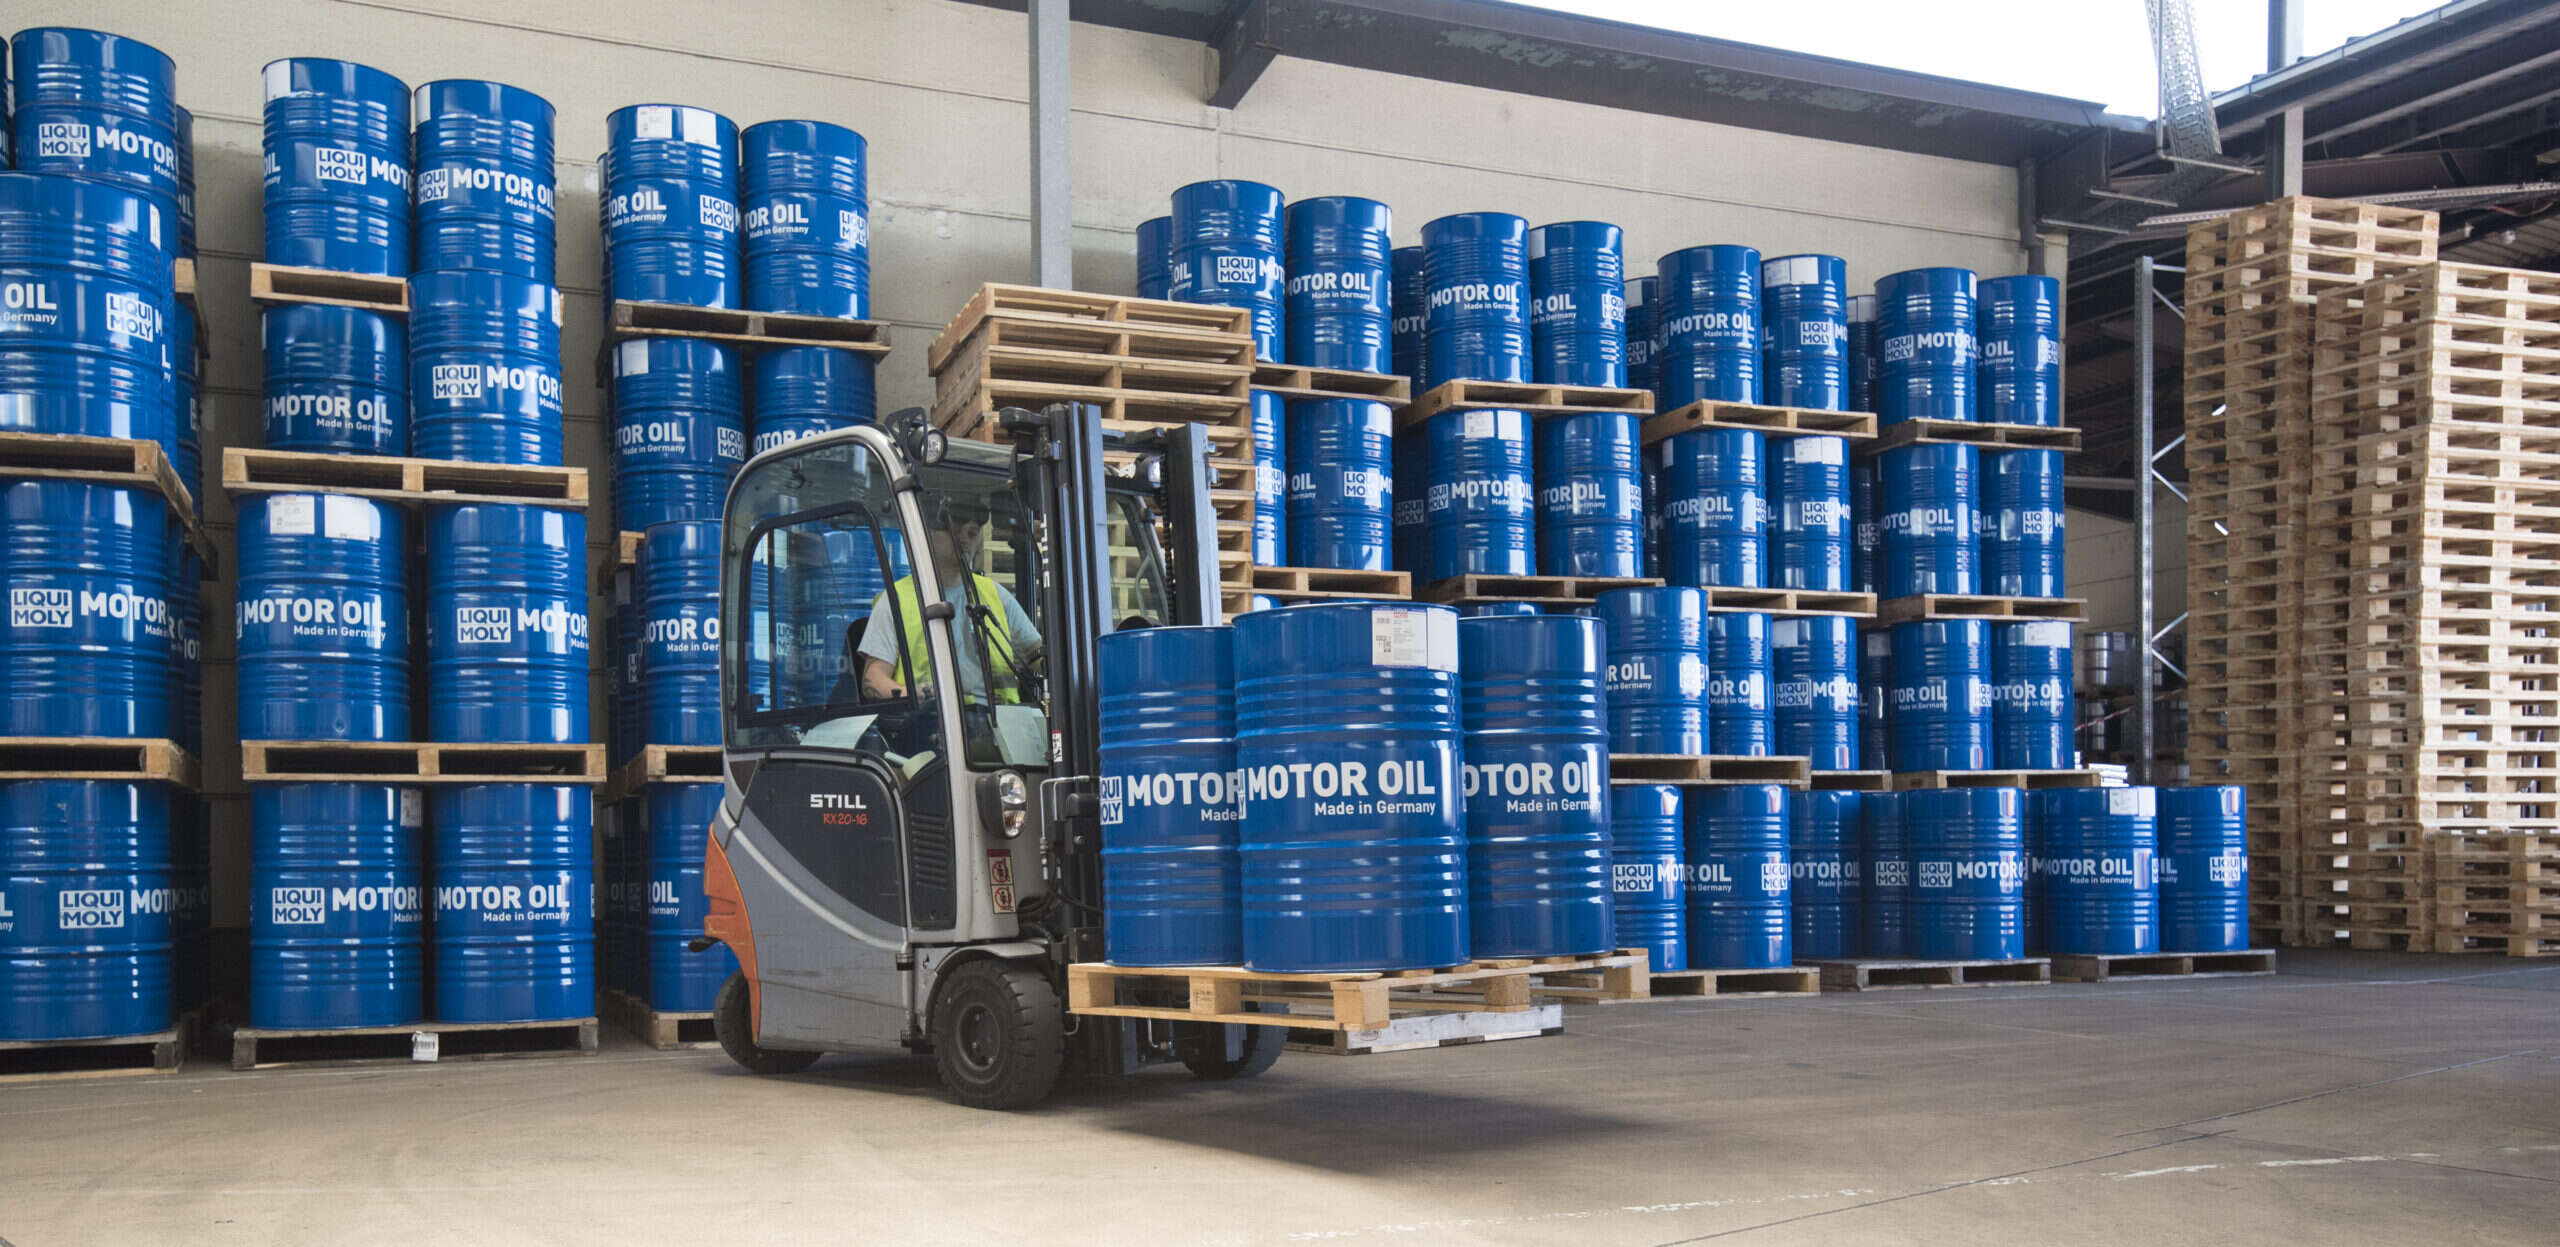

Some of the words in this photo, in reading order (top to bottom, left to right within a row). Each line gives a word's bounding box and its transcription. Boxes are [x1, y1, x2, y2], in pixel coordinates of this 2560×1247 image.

[41, 125, 88, 140] LIQUI
[42, 141, 89, 156] MOLY
[96, 125, 176, 171] MOTOR
[319, 149, 365, 170] LIQUI
[319, 163, 366, 183] MOLY
[371, 156, 412, 192] MOT
[452, 167, 536, 200] MOTOR
[504, 195, 529, 208] Made
[632, 189, 667, 211] OIL
[701, 195, 734, 216] LIQUI
[631, 212, 667, 224] Germany
[773, 203, 809, 224] OIL
[701, 212, 734, 233] MOLY
[772, 224, 809, 236] Germany
[1219, 256, 1254, 269] LIQUI
[1173, 261, 1193, 284] OIL
[1219, 269, 1255, 283] MOLY
[1341, 271, 1371, 291] OIL
[5, 283, 58, 311] OIL
[1311, 290, 1331, 300] Made
[1340, 290, 1371, 301] Germany
[1431, 284, 1490, 309] MOTOR
[1493, 282, 1520, 304] OIL
[1546, 293, 1576, 312] OIL
[108, 295, 153, 322] LIQUI
[1463, 301, 1482, 311] Made
[1484, 301, 1491, 311] in
[1492, 302, 1520, 314] Germy
[1545, 311, 1576, 323] Germany
[1669, 313, 1729, 337] MOTOR
[1732, 313, 1755, 333] OIL
[108, 314, 154, 341] MOLY
[1703, 330, 1722, 340] Made
[1801, 322, 1831, 334] LIQU
[1886, 335, 1913, 352] LIQUI
[1917, 331, 1972, 352] MOTOR
[1985, 340, 2014, 358] OIL
[1886, 347, 1913, 362] MOLY
[436, 365, 479, 381] LIQUI
[436, 382, 480, 398] MOLY
[487, 366, 560, 403] MOTOR
[271, 395, 351, 419] MOTOR
[357, 399, 394, 427] OIL
[316, 417, 347, 430] Made
[350, 420, 359, 430] in
[649, 422, 686, 442] OIL
[648, 443, 686, 455] Germany
[1291, 471, 1316, 493] OIL
[1450, 480, 1511, 500] MOTOR
[1540, 486, 1571, 507] TOR
[1576, 482, 1605, 501] OIL
[1703, 495, 1734, 513] OIL
[1803, 514, 1830, 525] MOL
[1925, 508, 1954, 524] OIL
[14, 590, 71, 607] LIQUI
[81, 590, 167, 626] MOTOR
[244, 598, 337, 625] MOTOR
[342, 600, 387, 629] OIL
[459, 608, 509, 624] LIQUI
[14, 608, 71, 626] MOLY
[517, 607, 588, 639] MOTOR
[293, 625, 325, 636] Made
[327, 625, 339, 636] in
[341, 626, 387, 643] Germy
[460, 625, 510, 642] MOLY
[666, 643, 689, 654] Made
[691, 642, 700, 653] in
[1621, 662, 1652, 681] OIL
[1620, 680, 1652, 693] Germany
[1777, 683, 1808, 694] LIQUI
[1918, 684, 1948, 702] OIL
[2040, 683, 2065, 700] OIL
[1777, 694, 1808, 706] MOLY
[1247, 762, 1369, 801] MOTOR
[1378, 760, 1436, 796] OIL
[1127, 772, 1239, 807] MOTOR
[809, 793, 868, 809] STILL
[1314, 802, 1354, 816] Made
[1359, 800, 1373, 814] in
[1376, 800, 1436, 816] Germany
[1506, 799, 1544, 813] Made
[1546, 799, 1559, 812] in
[1201, 808, 1238, 822] Made
[1614, 865, 1652, 878] LIQUI
[1657, 863, 1685, 883] MOT
[1698, 863, 1732, 882] OIL
[1877, 863, 1908, 874] LIQU
[1919, 863, 1952, 874] LIQUI
[1956, 861, 2018, 881] MOTOR
[2100, 857, 2133, 876] OIL
[1614, 879, 1653, 891] MOLY
[1697, 882, 1732, 895] Germany
[1919, 874, 1952, 887] MOLY
[2070, 876, 2088, 886] Made
[2099, 875, 2133, 887] Germany
[63, 892, 122, 909] LIQUI
[274, 889, 323, 905] LIQUI
[332, 886, 418, 911] MOTOR
[438, 885, 523, 911] MOTOR
[529, 884, 570, 909] OIL
[652, 881, 680, 904] OIL
[62, 910, 122, 927] MOLY
[274, 907, 323, 923] MOLY
[483, 911, 512, 922] Made
[514, 911, 525, 922] in
[527, 910, 570, 924] Germany
